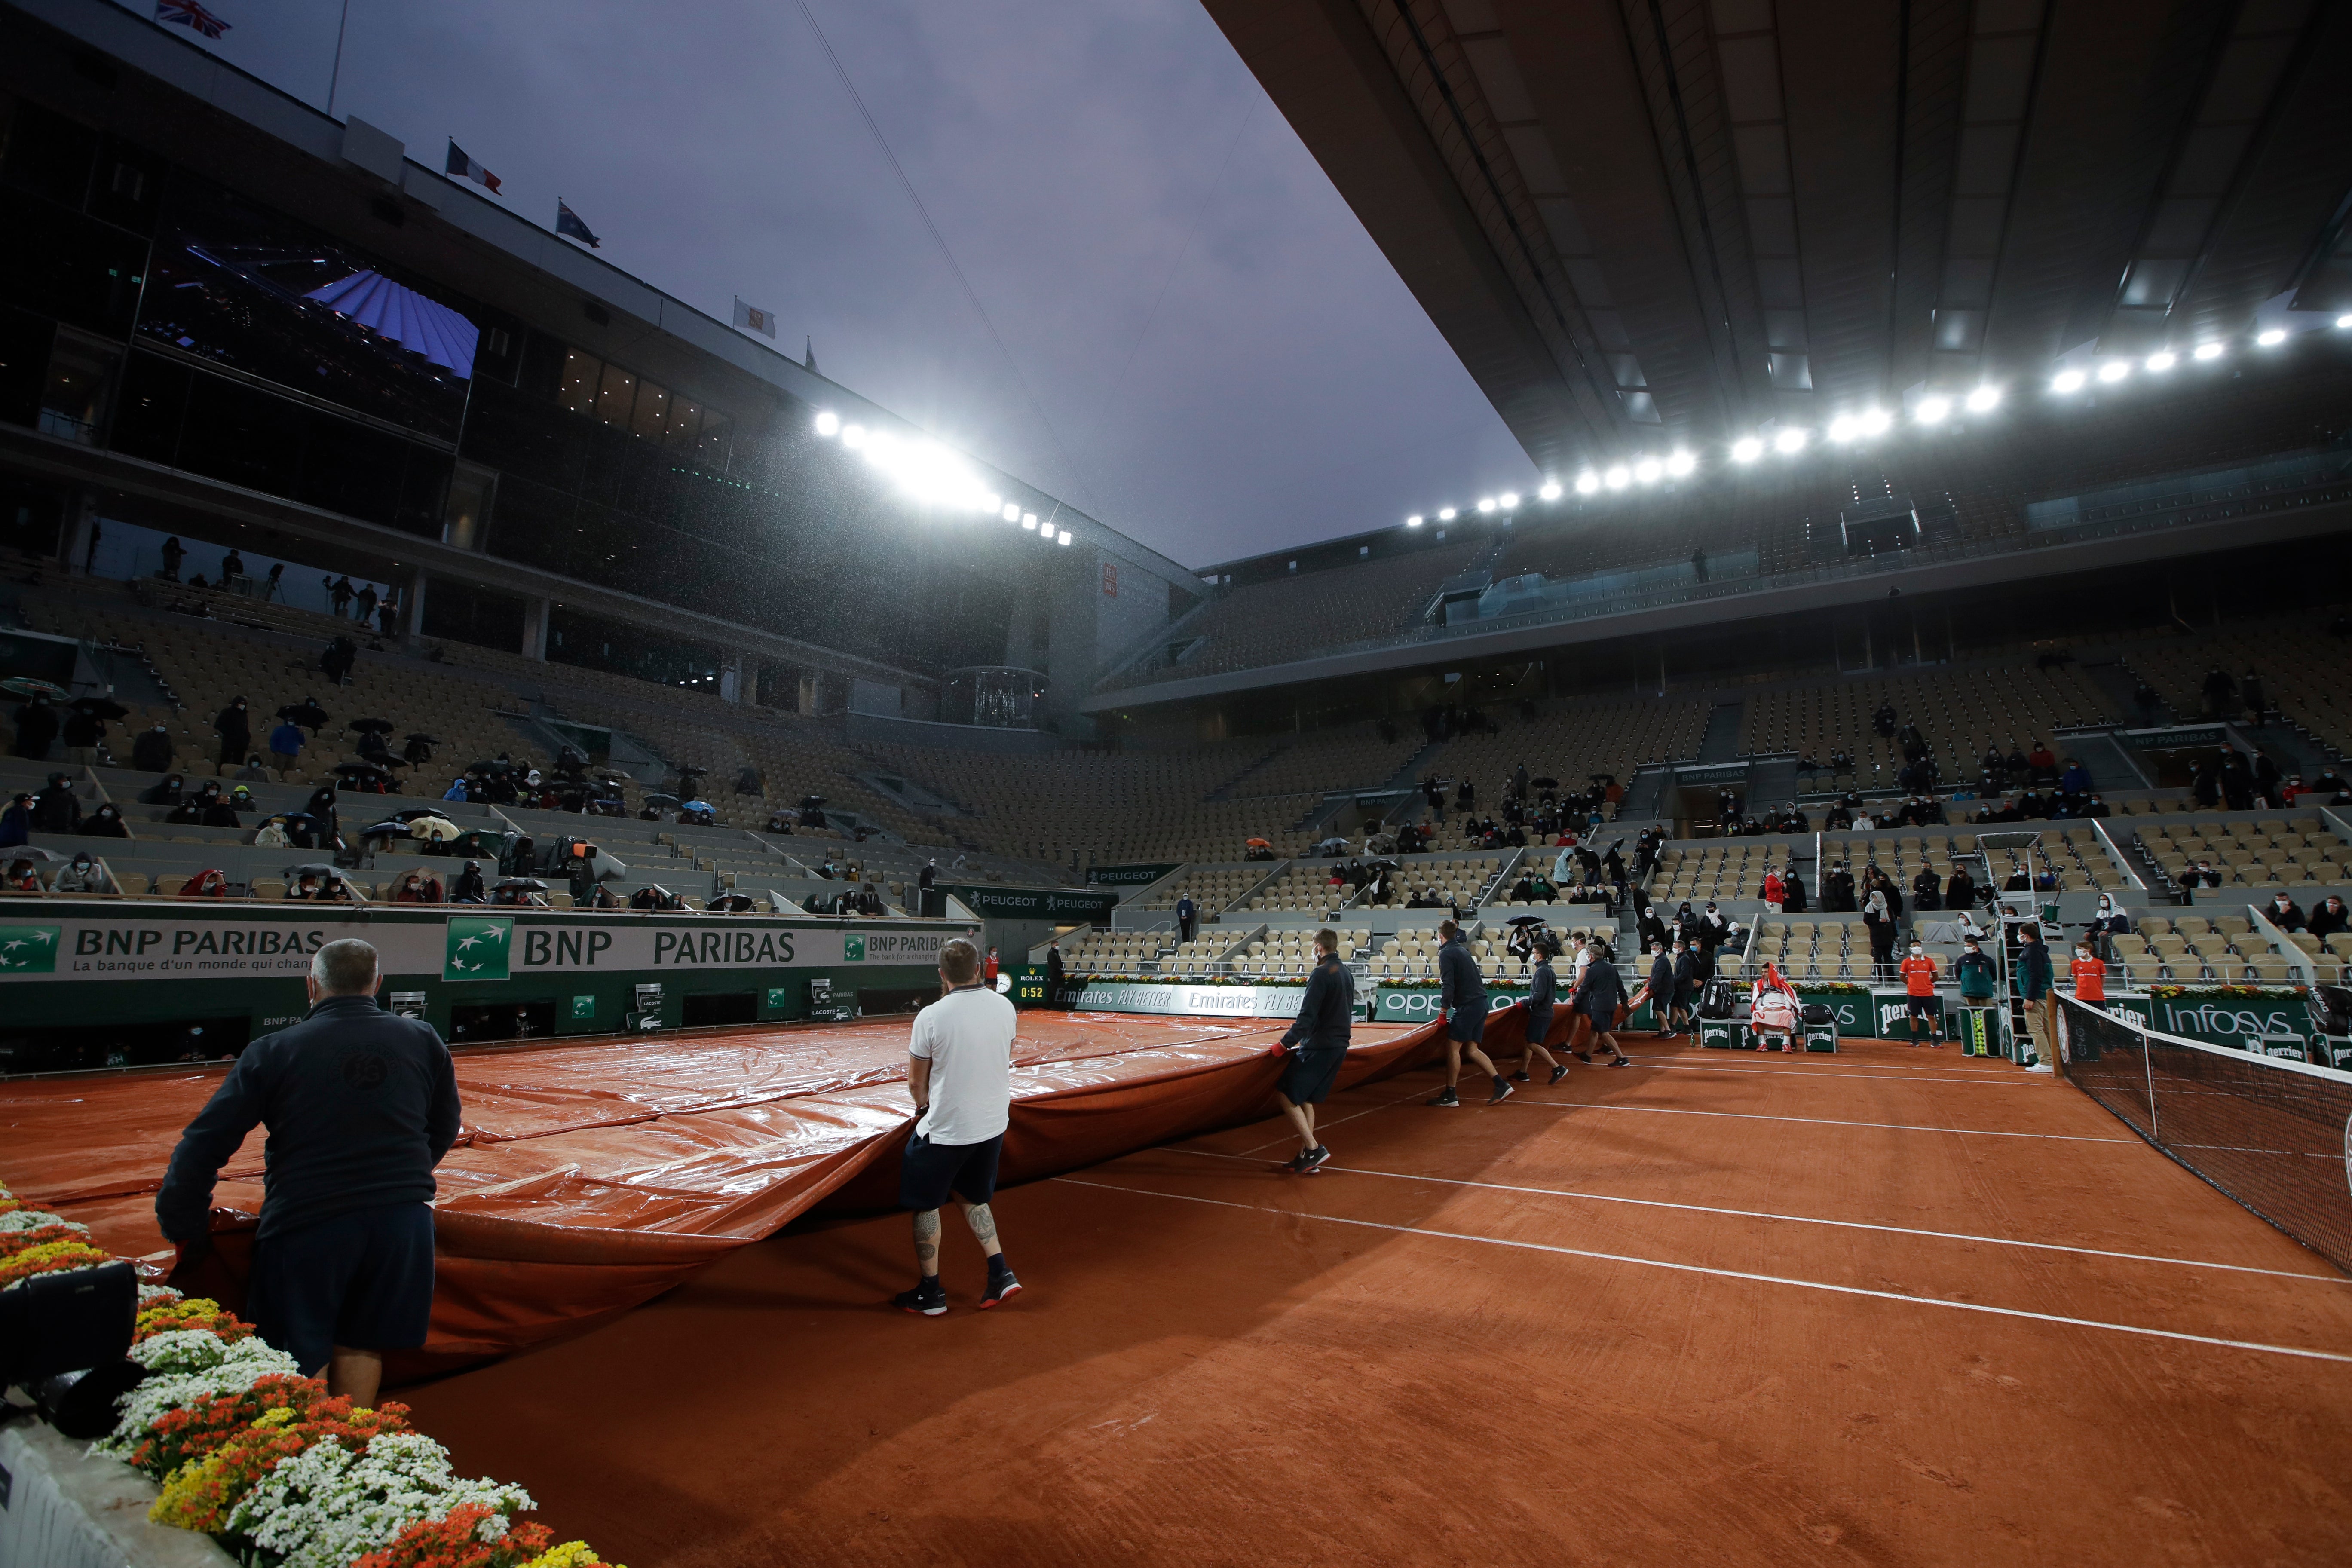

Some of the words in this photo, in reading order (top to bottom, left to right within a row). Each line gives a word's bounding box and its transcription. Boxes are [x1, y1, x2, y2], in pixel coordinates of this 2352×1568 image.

[2135, 737, 2153, 746] NP
[2157, 732, 2217, 744] PARIBAS
[1682, 773, 1702, 781] BNP
[1704, 770, 1746, 779] PARIBAS
[1100, 871, 1157, 881] PEUGEOT
[983, 895, 1037, 907] PEUGEOT
[1057, 899, 1103, 909] PEUGEOT
[75, 929, 162, 955] BNP
[173, 930, 325, 955] PARIBAS
[524, 930, 612, 966] BNP
[654, 932, 795, 964] PARIBAS
[869, 936, 897, 952] BNP
[901, 936, 953, 952] PARIBA
[912, 953, 936, 961] changing
[73, 961, 91, 971] La
[98, 960, 155, 973] banque
[161, 959, 193, 971] d'un
[199, 958, 247, 970] monde
[252, 958, 272, 971] qui
[1021, 987, 1043, 998] 0:52
[1054, 988, 1114, 1004] Emirates
[1118, 989, 1136, 1005] FLY
[1134, 991, 1171, 1007] BETTER
[2309, 986, 2330, 1013] HEAD
[1188, 992, 1258, 1009] Emirates
[1263, 994, 1284, 1010] FLY
[1386, 994, 1442, 1016] opp
[263, 1017, 287, 1026] BNP
[2164, 1003, 2292, 1034] Infosys
[1703, 1027, 1729, 1044] perrier
[1806, 1031, 1833, 1047] perrier
